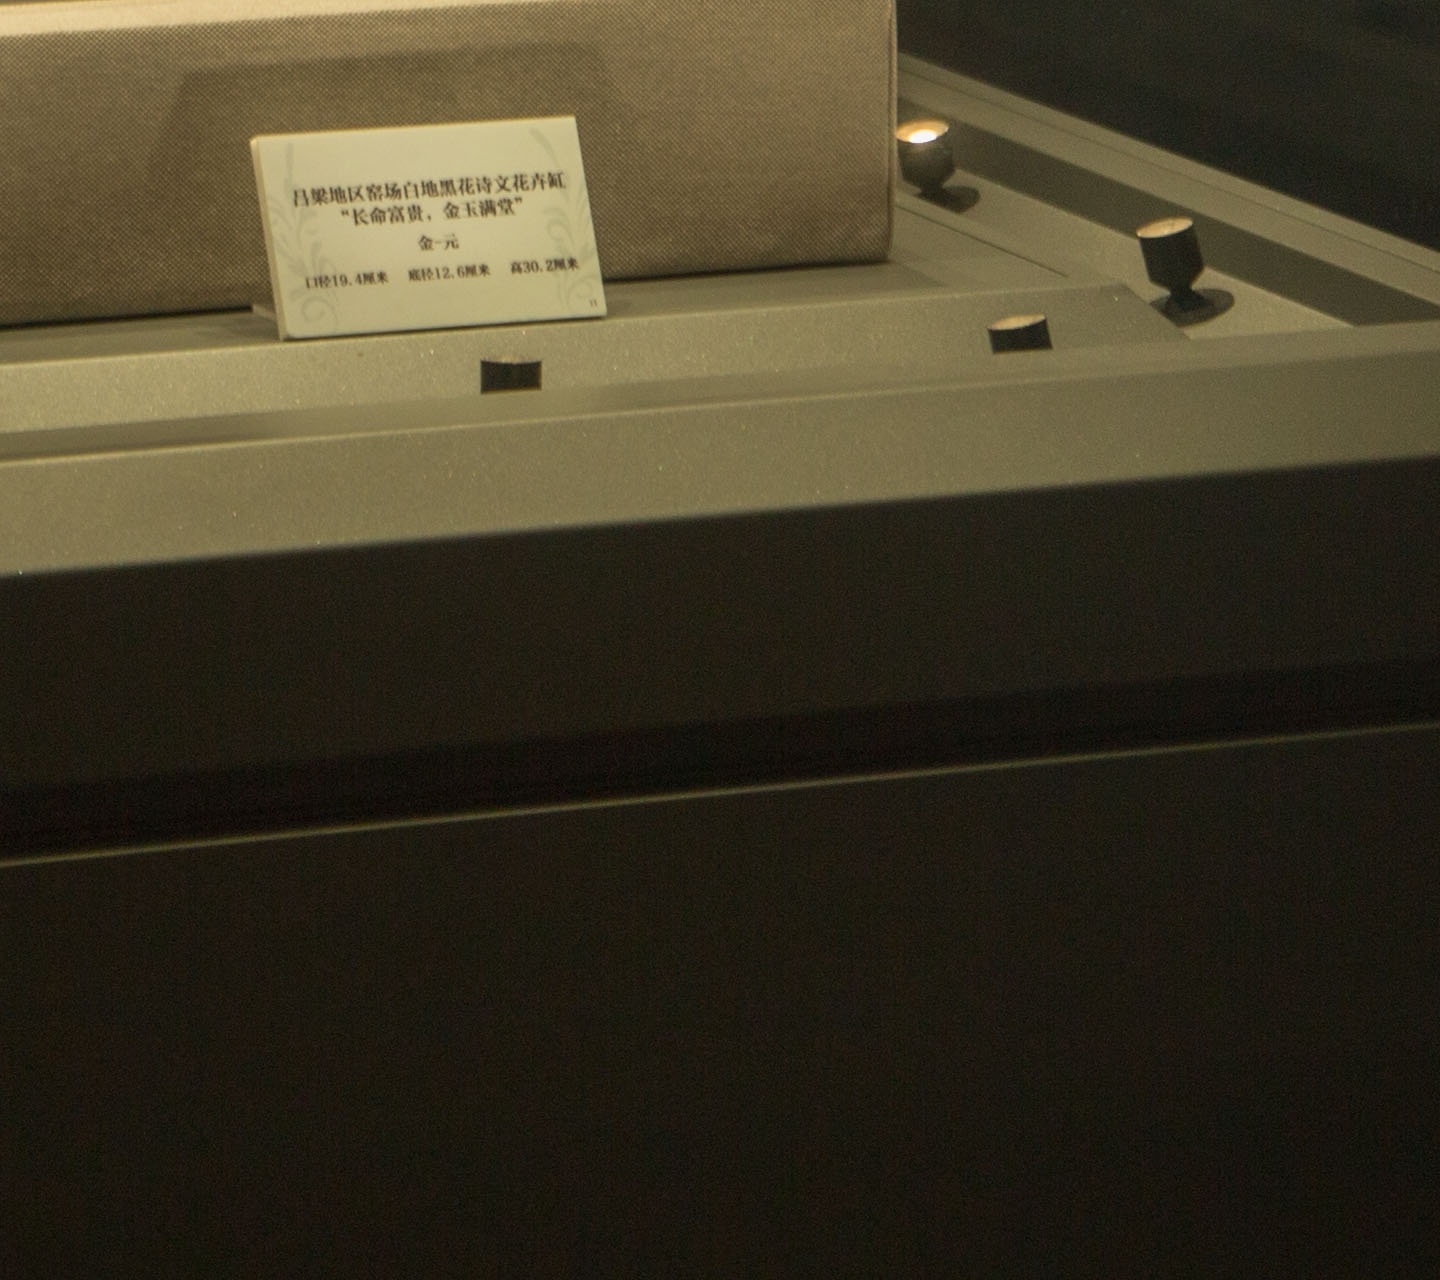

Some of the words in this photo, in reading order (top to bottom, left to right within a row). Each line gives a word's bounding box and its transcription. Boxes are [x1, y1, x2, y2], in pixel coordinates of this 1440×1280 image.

[292, 170, 567, 209] 吕梁地区窑场白地黑花诗文花卉缸
[305, 270, 390, 290] 口径19.4厘米
[510, 256, 580, 276] 高30.2厘米
